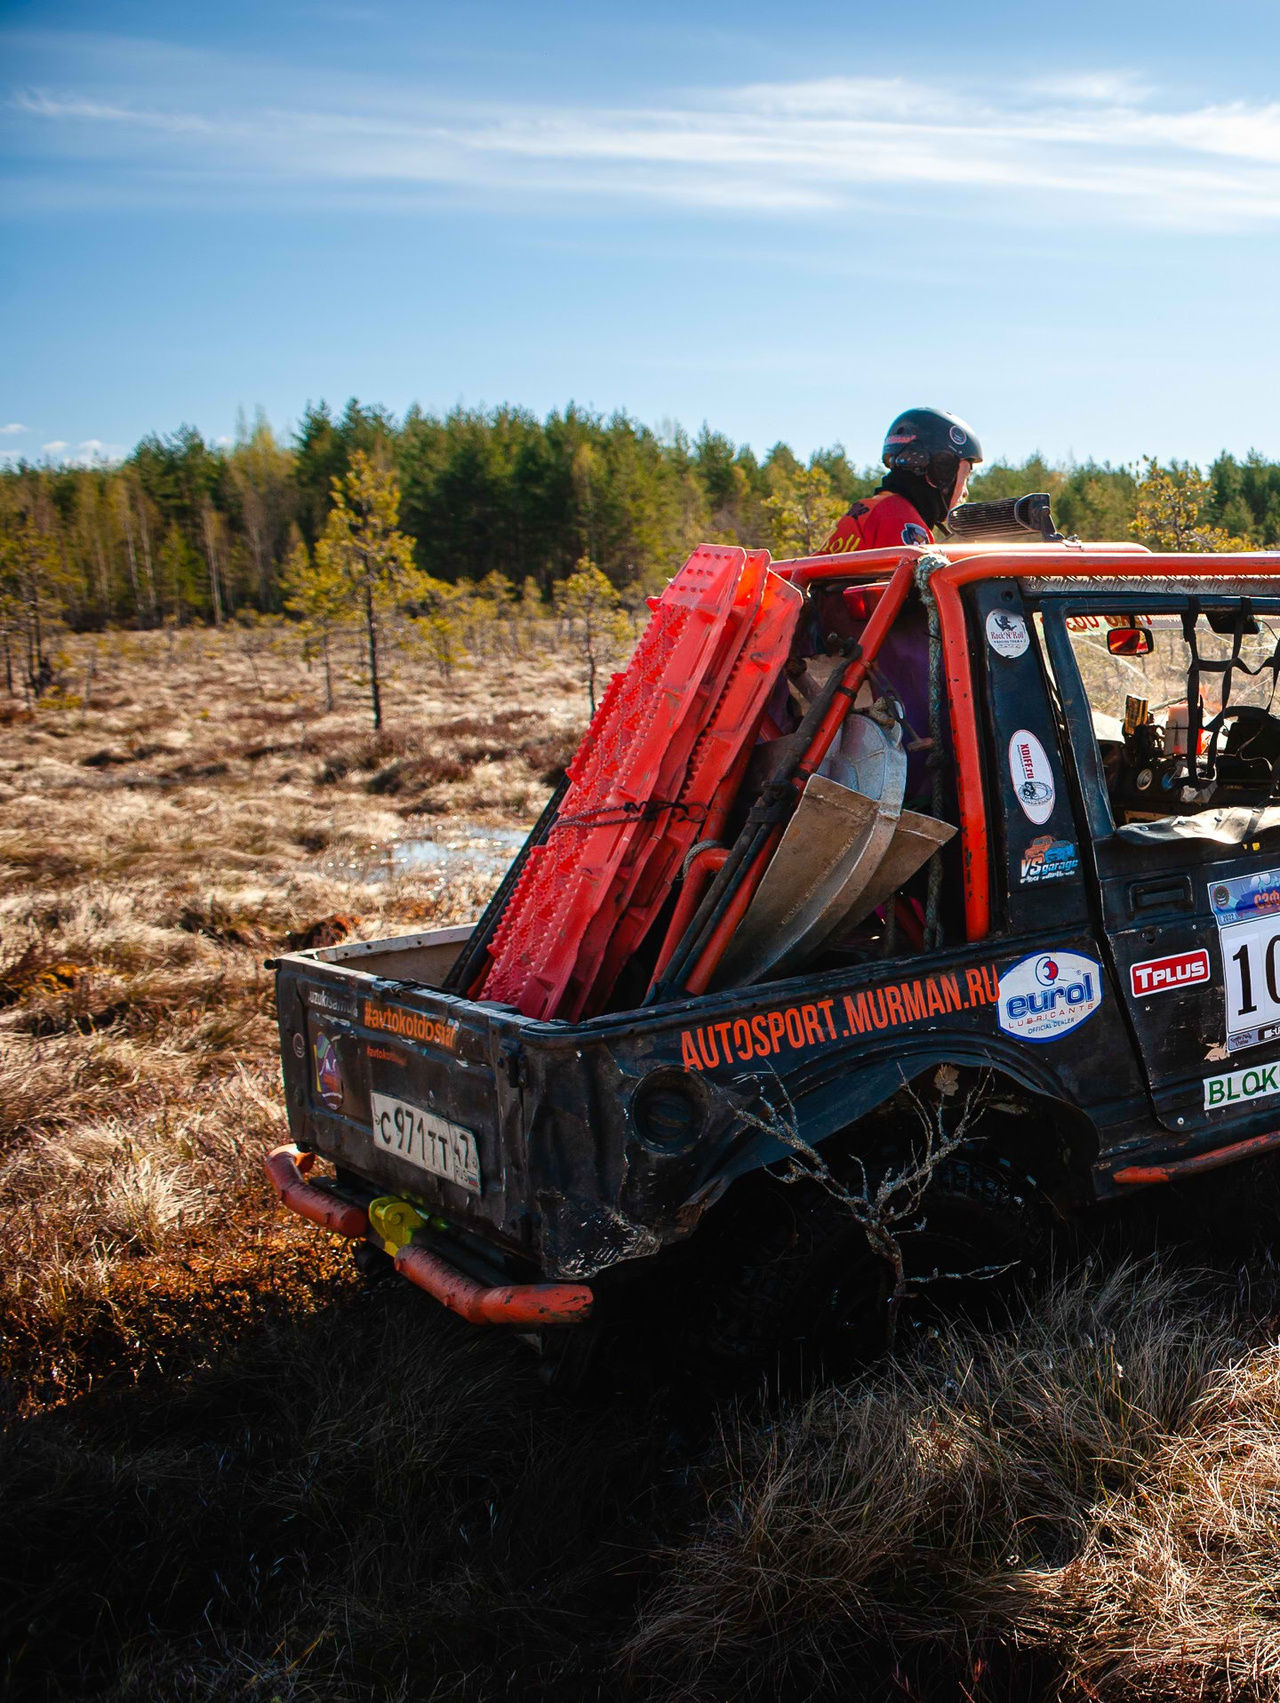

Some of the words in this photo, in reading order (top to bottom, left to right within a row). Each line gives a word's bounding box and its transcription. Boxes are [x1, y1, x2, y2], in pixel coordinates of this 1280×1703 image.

[1021, 857, 1043, 877] VS
[1135, 960, 1206, 989] TPLUS
[1006, 972, 1094, 1019] eurol
[1008, 1003, 1094, 1029] LUBRICANTS
[1028, 1023, 1052, 1034] OFFICIAL
[1053, 1017, 1075, 1028] DEALER
